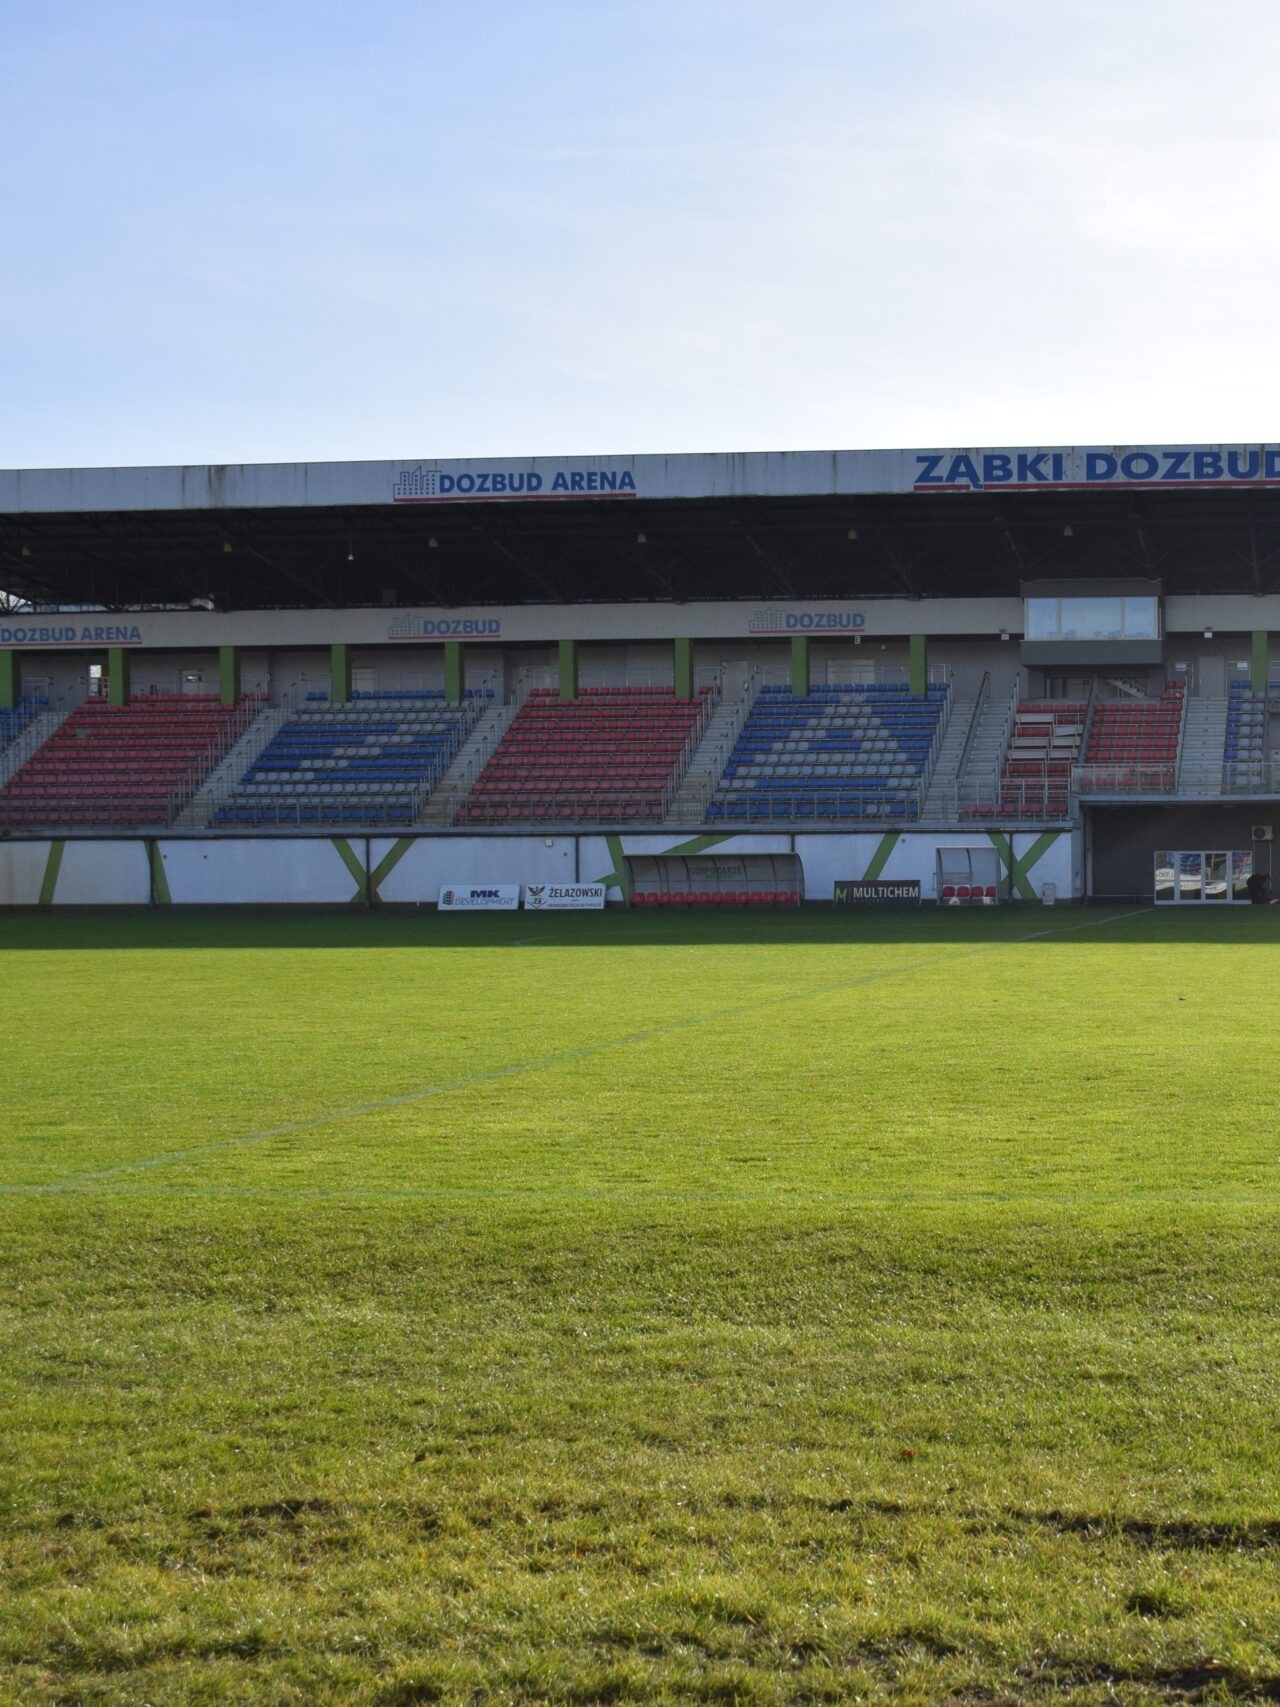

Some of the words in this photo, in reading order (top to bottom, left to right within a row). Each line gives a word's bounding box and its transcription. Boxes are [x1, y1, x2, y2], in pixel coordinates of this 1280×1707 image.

[914, 453, 1063, 489] ZĄBKI
[439, 472, 543, 494] DOZBUD
[551, 470, 637, 491] ARENA
[423, 619, 501, 635] DOZBUD
[785, 612, 866, 629] DOZBUD
[1, 627, 77, 642] DOZBUD
[81, 626, 142, 641] ARENA
[470, 890, 500, 898] MK
[549, 886, 603, 898] ŻELAZOWSKI
[853, 887, 919, 898] MULTICHEM
